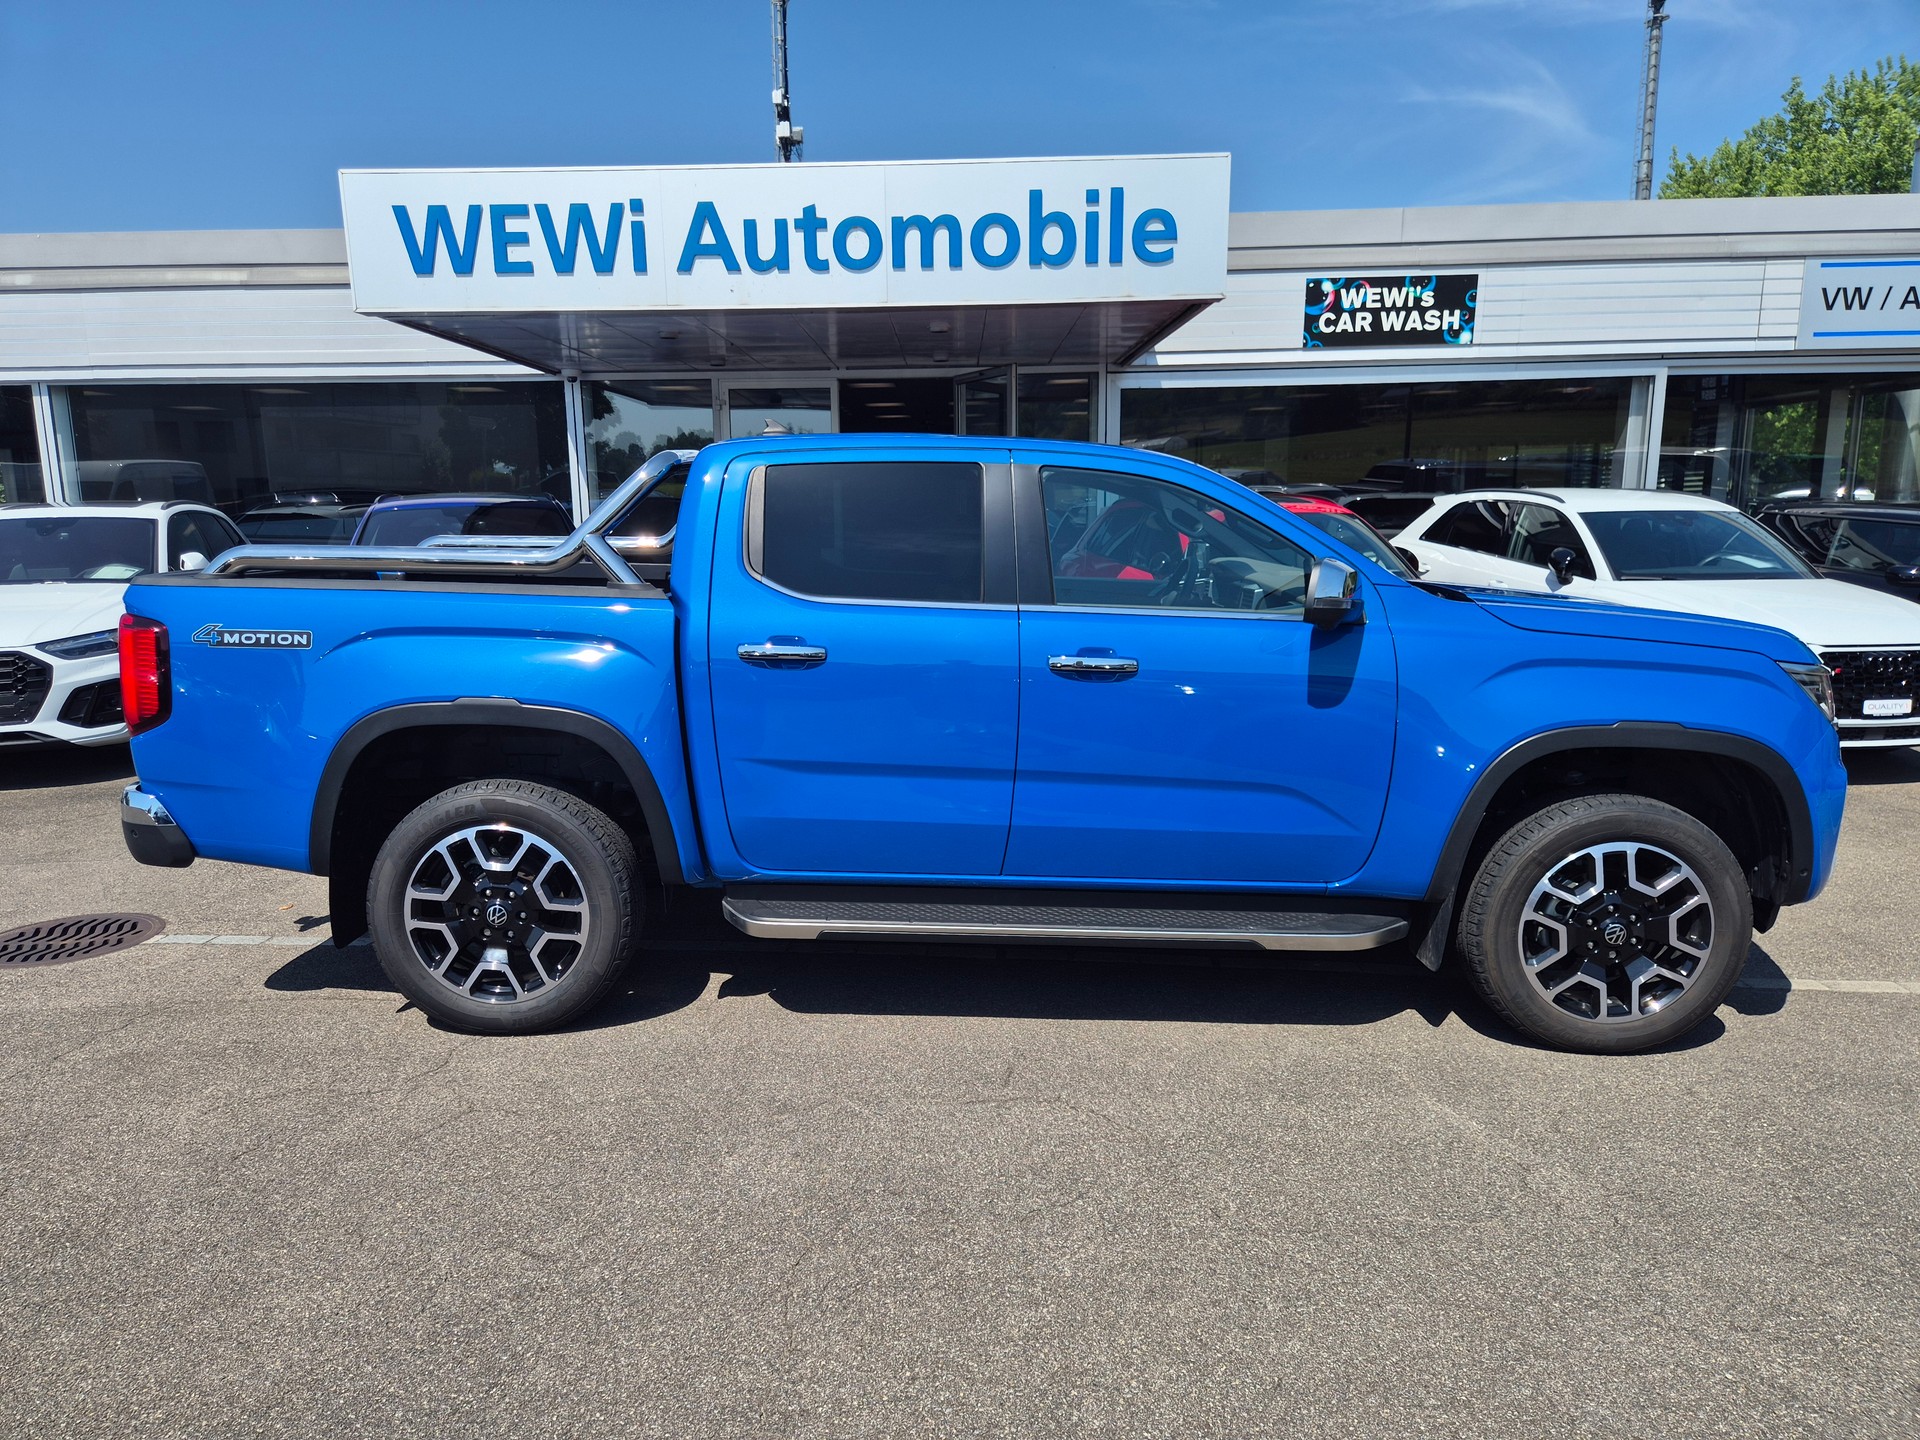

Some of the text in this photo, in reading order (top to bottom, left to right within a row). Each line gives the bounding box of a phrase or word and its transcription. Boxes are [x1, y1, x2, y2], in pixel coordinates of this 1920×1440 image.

[392, 187, 1178, 276] WEWi Automobile
[1341, 286, 1434, 308] WEWi's
[1821, 286, 1874, 311] VW
[1319, 310, 1461, 333] CAR WASH
